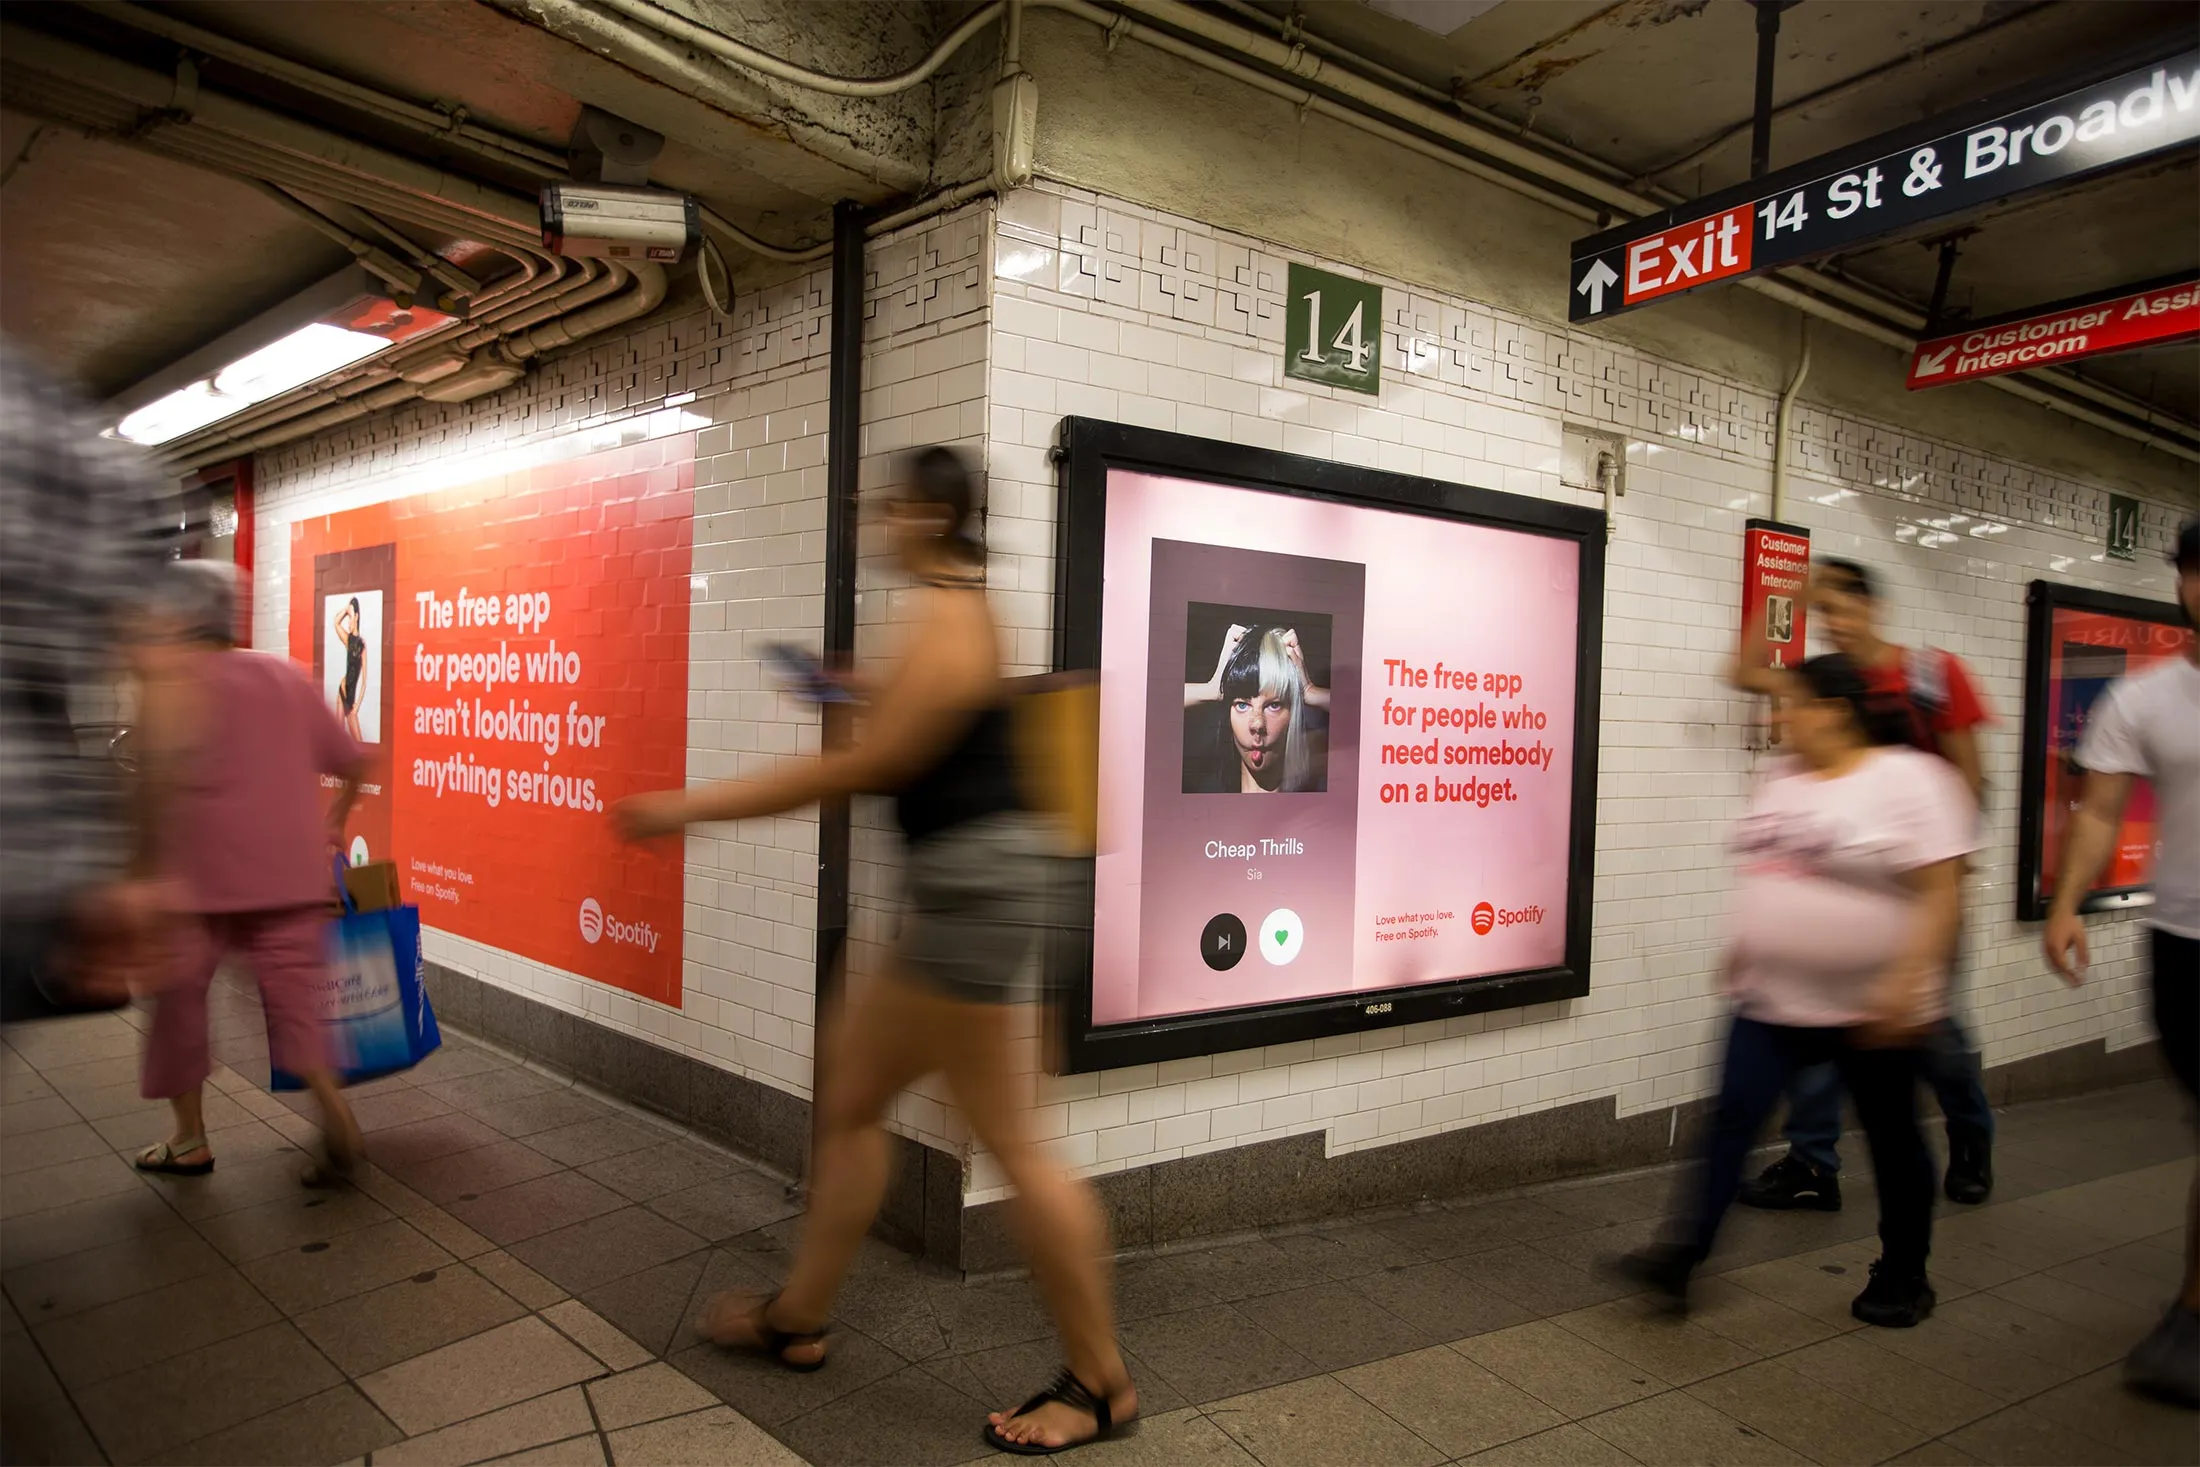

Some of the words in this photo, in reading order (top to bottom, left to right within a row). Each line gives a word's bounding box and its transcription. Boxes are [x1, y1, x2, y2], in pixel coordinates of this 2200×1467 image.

[1758, 191, 1808, 240] 14
[1827, 166, 1884, 219] St
[1902, 147, 1943, 197] &
[1628, 214, 1740, 296] Exit
[1301, 290, 1369, 374] 14
[1962, 309, 2113, 353] Customer
[1954, 335, 2088, 374] Intercom
[1761, 535, 1806, 556] Customer
[2112, 508, 2135, 550] 14
[1757, 553, 1808, 574] Assistance
[1761, 573, 1802, 591] Intercom
[416, 590, 453, 629] The
[457, 586, 500, 627] free
[505, 591, 550, 634] app
[414, 643, 443, 681] for
[446, 640, 520, 692] people
[525, 639, 580, 684] who
[1384, 659, 1428, 688] The
[1434, 662, 1477, 691] free
[1483, 673, 1522, 699] app
[414, 698, 470, 737] aren’t
[475, 698, 560, 756] looking
[566, 701, 606, 747] for
[1383, 697, 1416, 726] for
[1422, 702, 1497, 734] people
[1502, 704, 1547, 730] who
[1381, 738, 1438, 765] need
[1443, 739, 1553, 771] somebody
[413, 752, 501, 807] anything
[507, 760, 603, 813] serious.
[1380, 783, 1409, 803] on
[1415, 783, 1428, 803] a
[1434, 775, 1518, 808] budget.
[1205, 840, 1256, 861] Cheap
[1260, 838, 1304, 856] Thrills
[411, 857, 426, 872] Love
[427, 861, 443, 876] what
[444, 867, 457, 880] you
[457, 867, 474, 884] love.
[1247, 868, 1263, 880] Sia
[411, 877, 425, 893] Free
[426, 884, 435, 895] on
[435, 883, 460, 904] Spotify.
[1376, 915, 1396, 926] Love
[1398, 911, 1418, 923] what
[1420, 913, 1434, 925] you
[1436, 910, 1455, 920] love.
[1498, 905, 1544, 927] Spotify
[606, 914, 659, 954] Spotify
[1375, 931, 1394, 942] Free
[1396, 932, 1406, 940] on
[1408, 926, 1438, 940] Spotify.
[1365, 1002, 1392, 1015] 406-088
